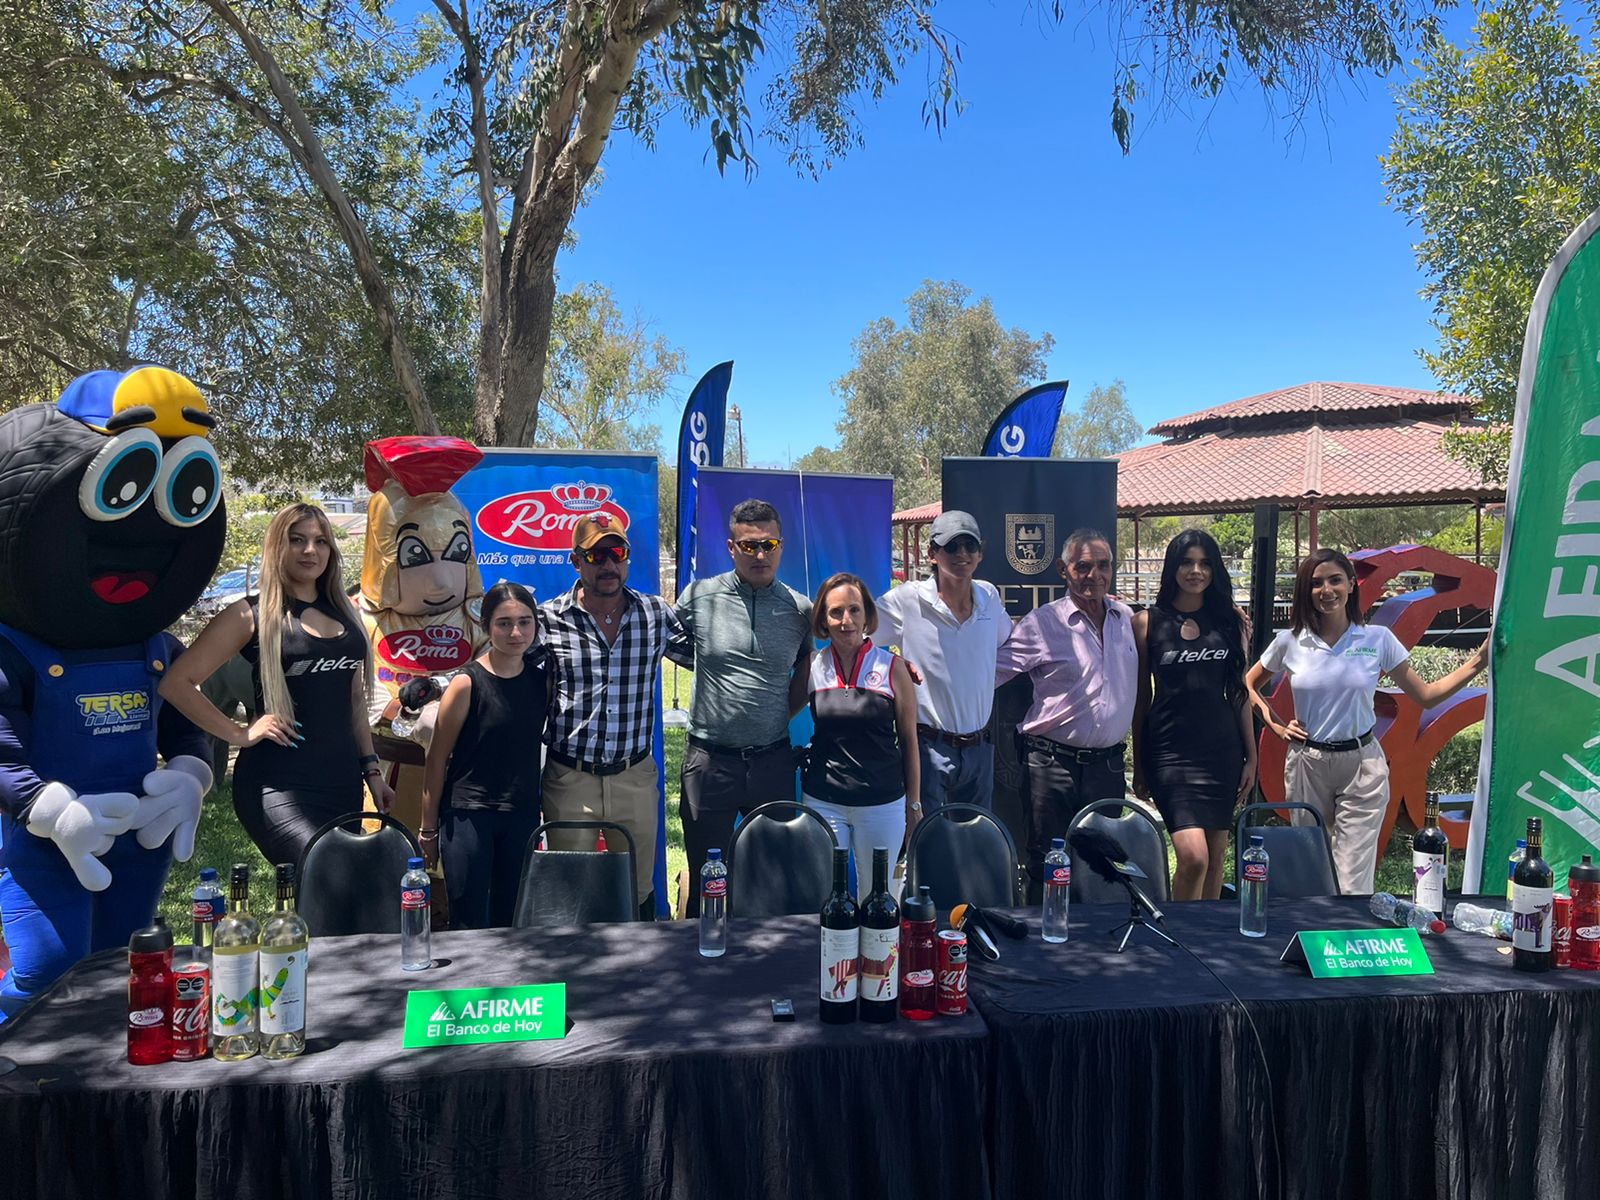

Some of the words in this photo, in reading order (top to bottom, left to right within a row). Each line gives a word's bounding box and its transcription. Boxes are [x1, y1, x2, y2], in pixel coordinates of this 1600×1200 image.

[690, 411, 710, 467] 5G
[999, 425, 1025, 457] G
[502, 499, 585, 538] Rom
[477, 552, 508, 565] Más
[511, 554, 536, 567] que
[539, 554, 564, 565] una
[997, 584, 1066, 619] ETT
[391, 635, 458, 661] Roma
[1178, 648, 1229, 663] telcel
[311, 656, 364, 673] telce
[80, 693, 147, 719] TERSA
[1345, 938, 1408, 955] AFIRME
[1325, 958, 1337, 969] El
[1340, 957, 1373, 969] Banco
[1376, 957, 1390, 967] de
[1390, 955, 1412, 968] Hoy
[459, 997, 544, 1019] AFIRME
[427, 1024, 440, 1037] El
[445, 1022, 490, 1036] Banco
[493, 1020, 511, 1033] de
[514, 1019, 543, 1034] Hoy
